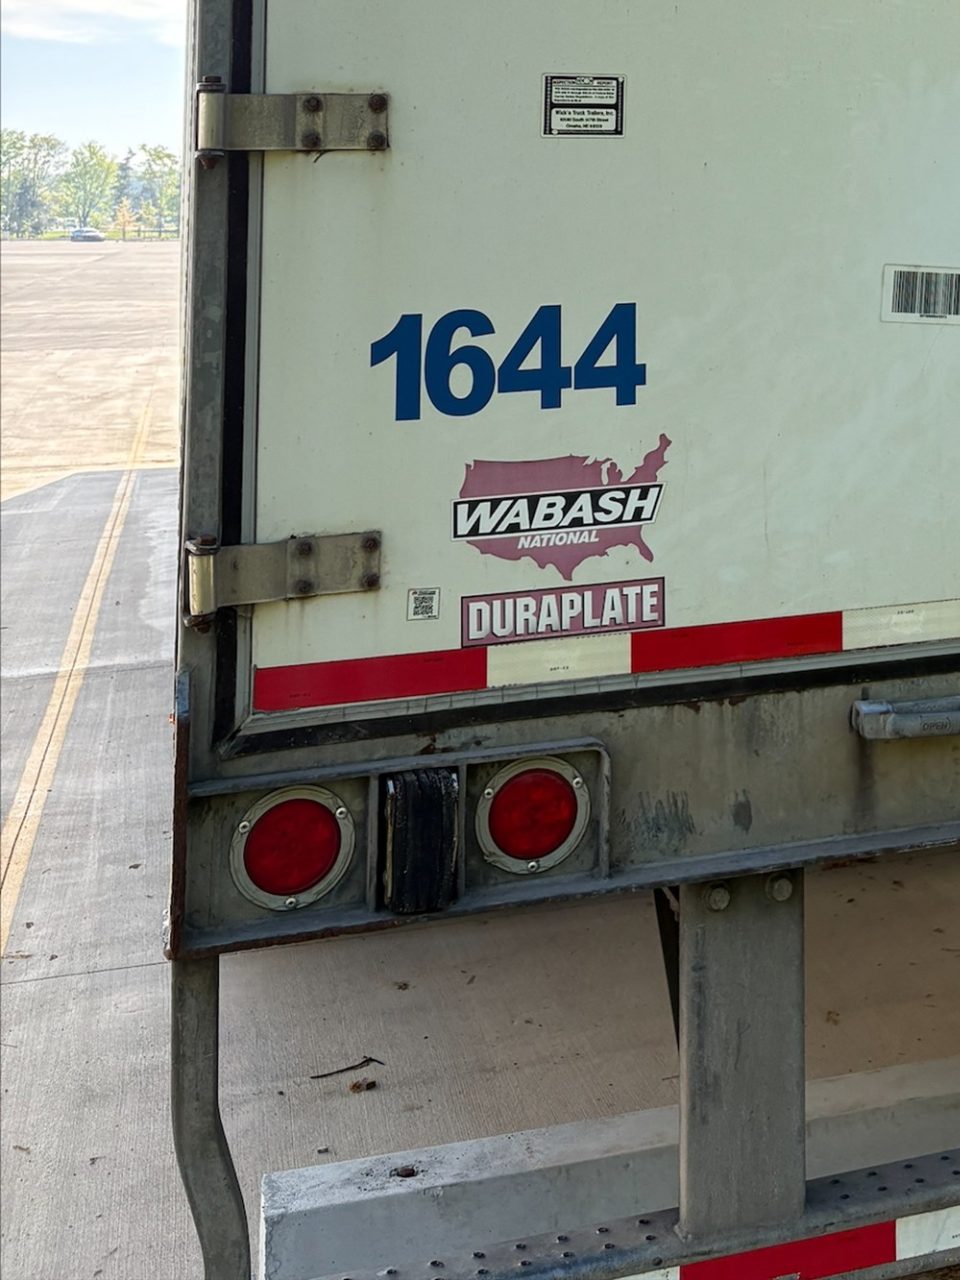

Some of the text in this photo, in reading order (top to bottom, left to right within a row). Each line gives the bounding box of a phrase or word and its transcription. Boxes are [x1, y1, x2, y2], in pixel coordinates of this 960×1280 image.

[370, 303, 646, 420] 1644
[456, 487, 660, 536] WABASH
[517, 530, 599, 549] NATIONAL
[468, 584, 659, 640] DURAPLATE
[922, 721, 948, 732] OPEN
